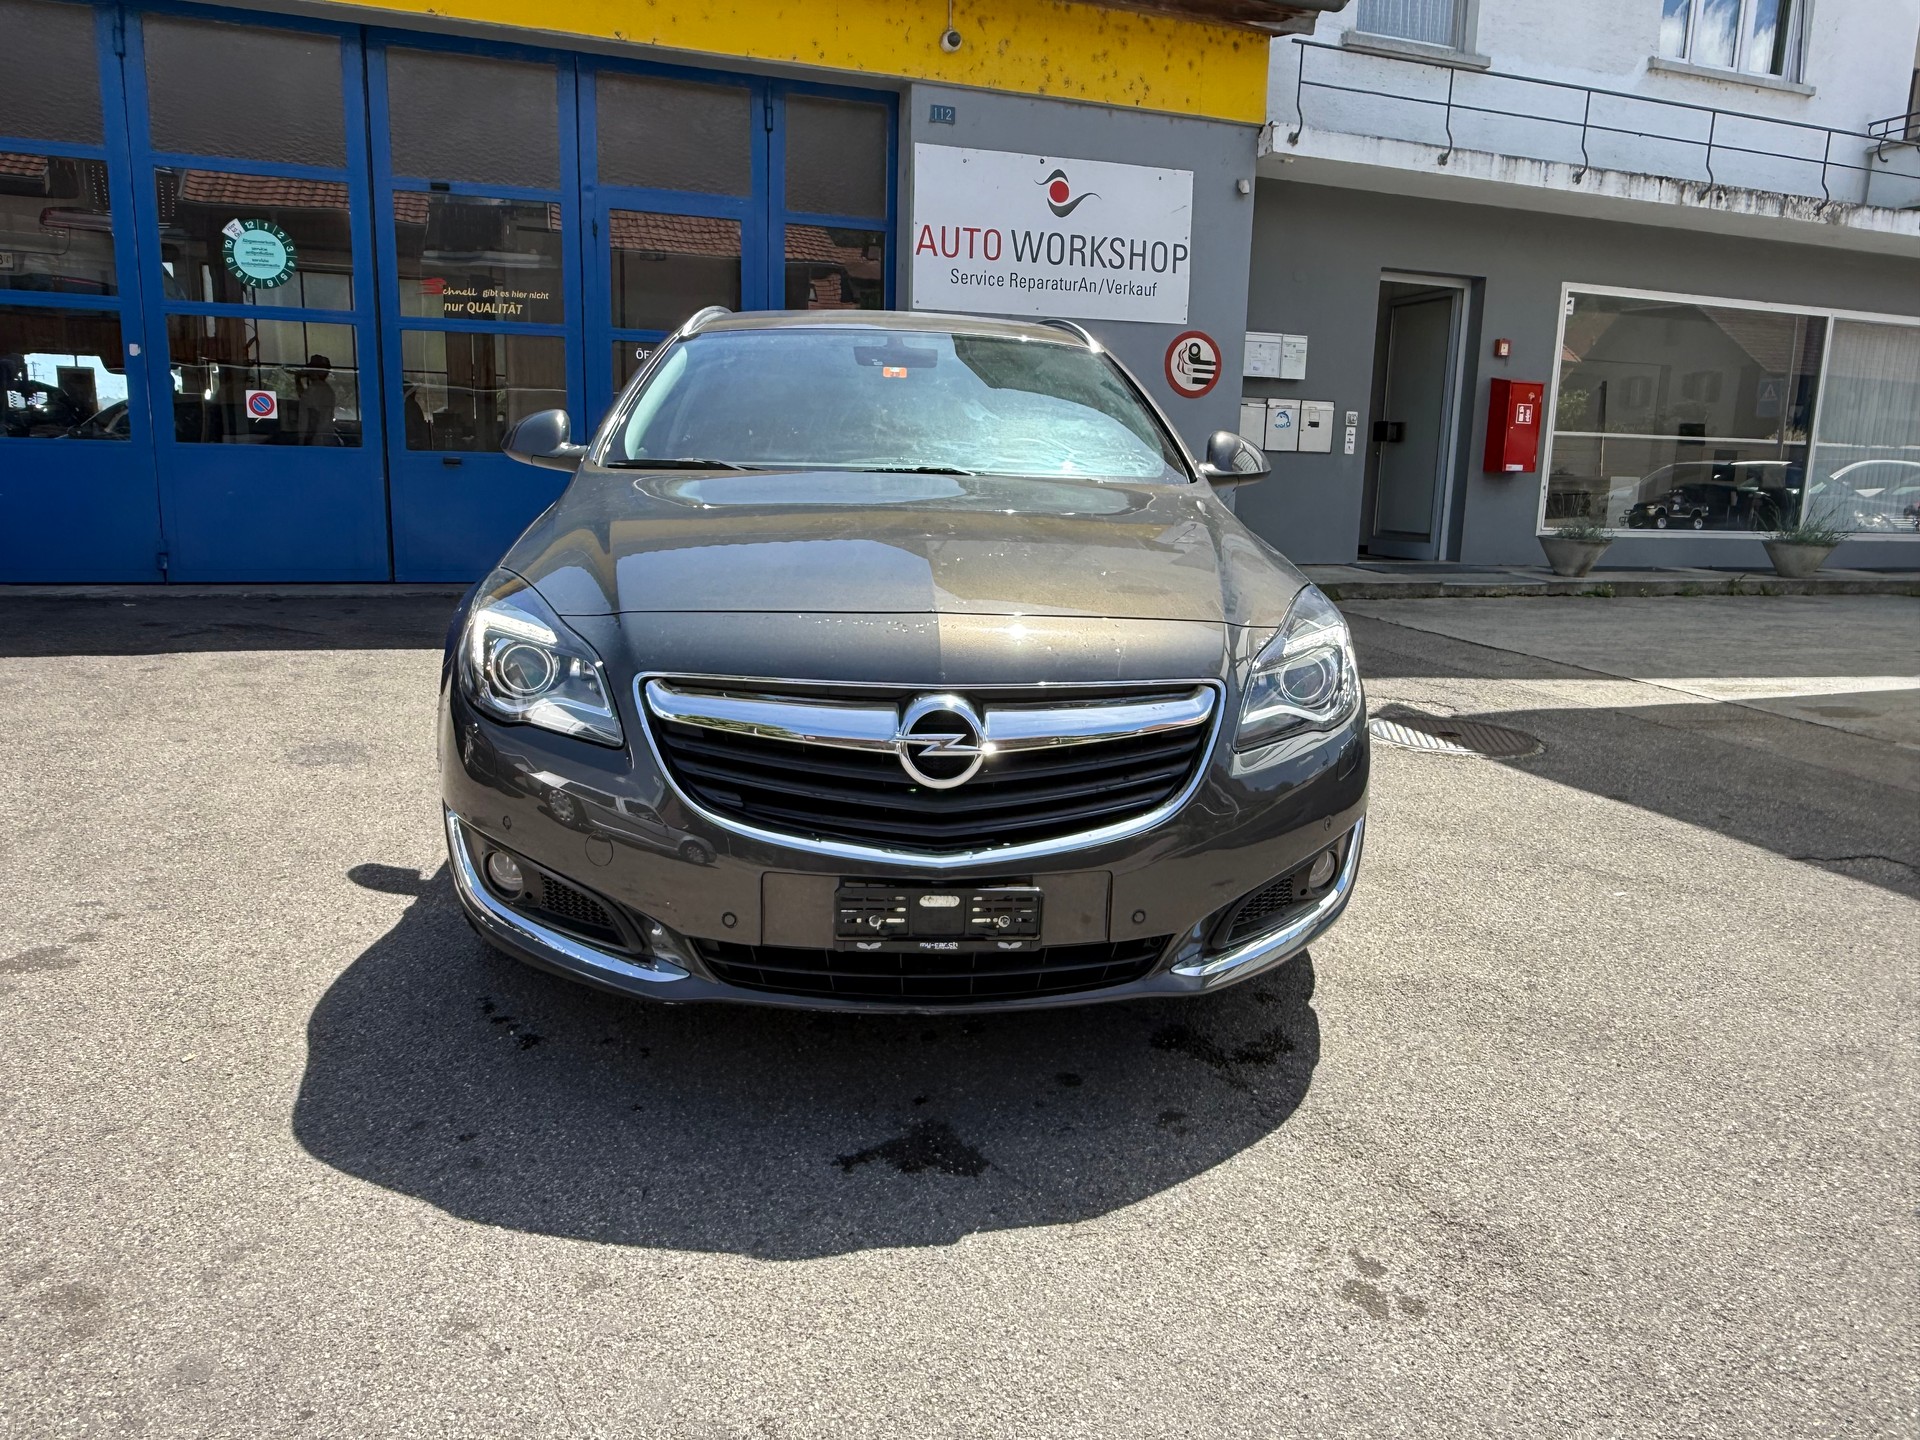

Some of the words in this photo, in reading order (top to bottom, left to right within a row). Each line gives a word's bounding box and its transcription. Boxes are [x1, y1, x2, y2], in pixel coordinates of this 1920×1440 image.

[934, 107, 951, 120] 112
[245, 221, 254, 229] 12
[225, 240, 233, 248] 10
[915, 224, 1002, 261] AUTO
[1010, 229, 1189, 274] WORKSHOP
[950, 268, 1004, 287] Service
[1009, 272, 1157, 297] ReparaturAn/Verkauf
[482, 289, 498, 298] gibt
[511, 290, 527, 299] hier
[529, 291, 549, 300] nicht
[444, 302, 464, 312] nur
[467, 301, 523, 315] QUALITÄT
